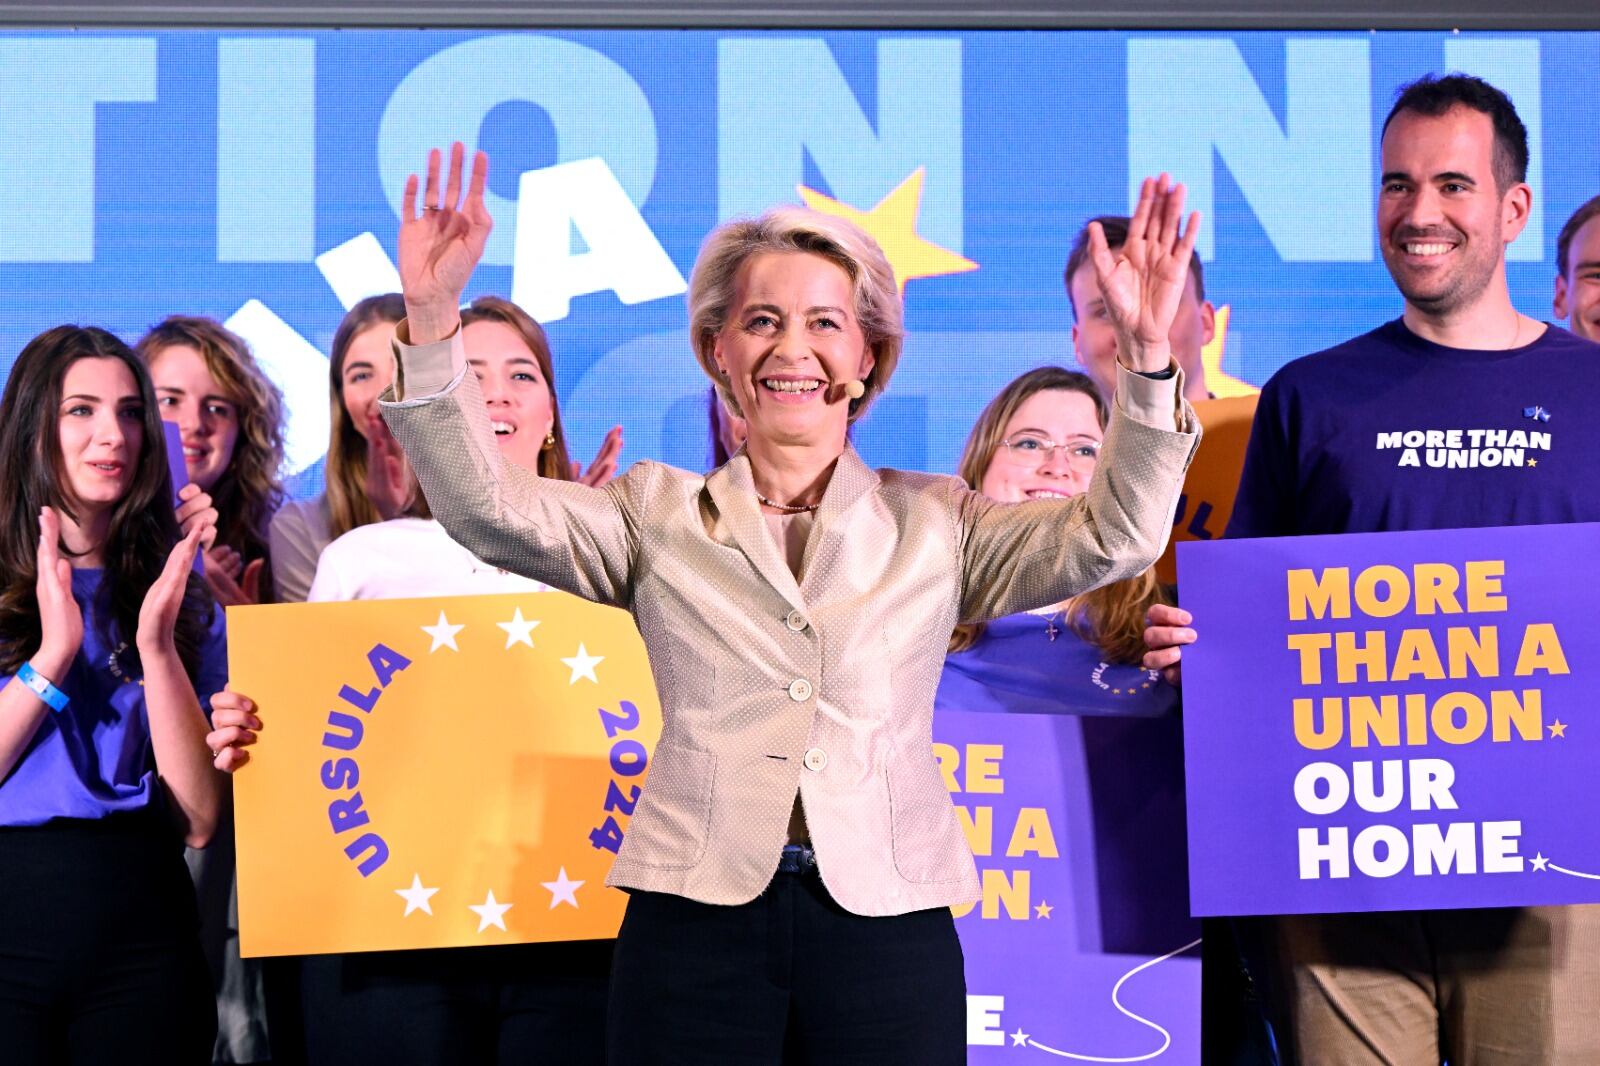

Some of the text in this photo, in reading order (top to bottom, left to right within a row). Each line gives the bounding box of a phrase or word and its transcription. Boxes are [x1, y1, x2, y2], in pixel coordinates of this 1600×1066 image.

[1376, 429, 1552, 451] MORE THAN
[1398, 447, 1526, 469] A UNION
[1286, 561, 1508, 622] MORE
[1287, 623, 1570, 686] THAN A
[1293, 690, 1543, 750] UNION
[320, 642, 411, 878] URSULA
[590, 699, 649, 855] 2024
[1293, 758, 1459, 815] OUR
[1006, 808, 1059, 858] A
[1298, 820, 1524, 880] HOME
